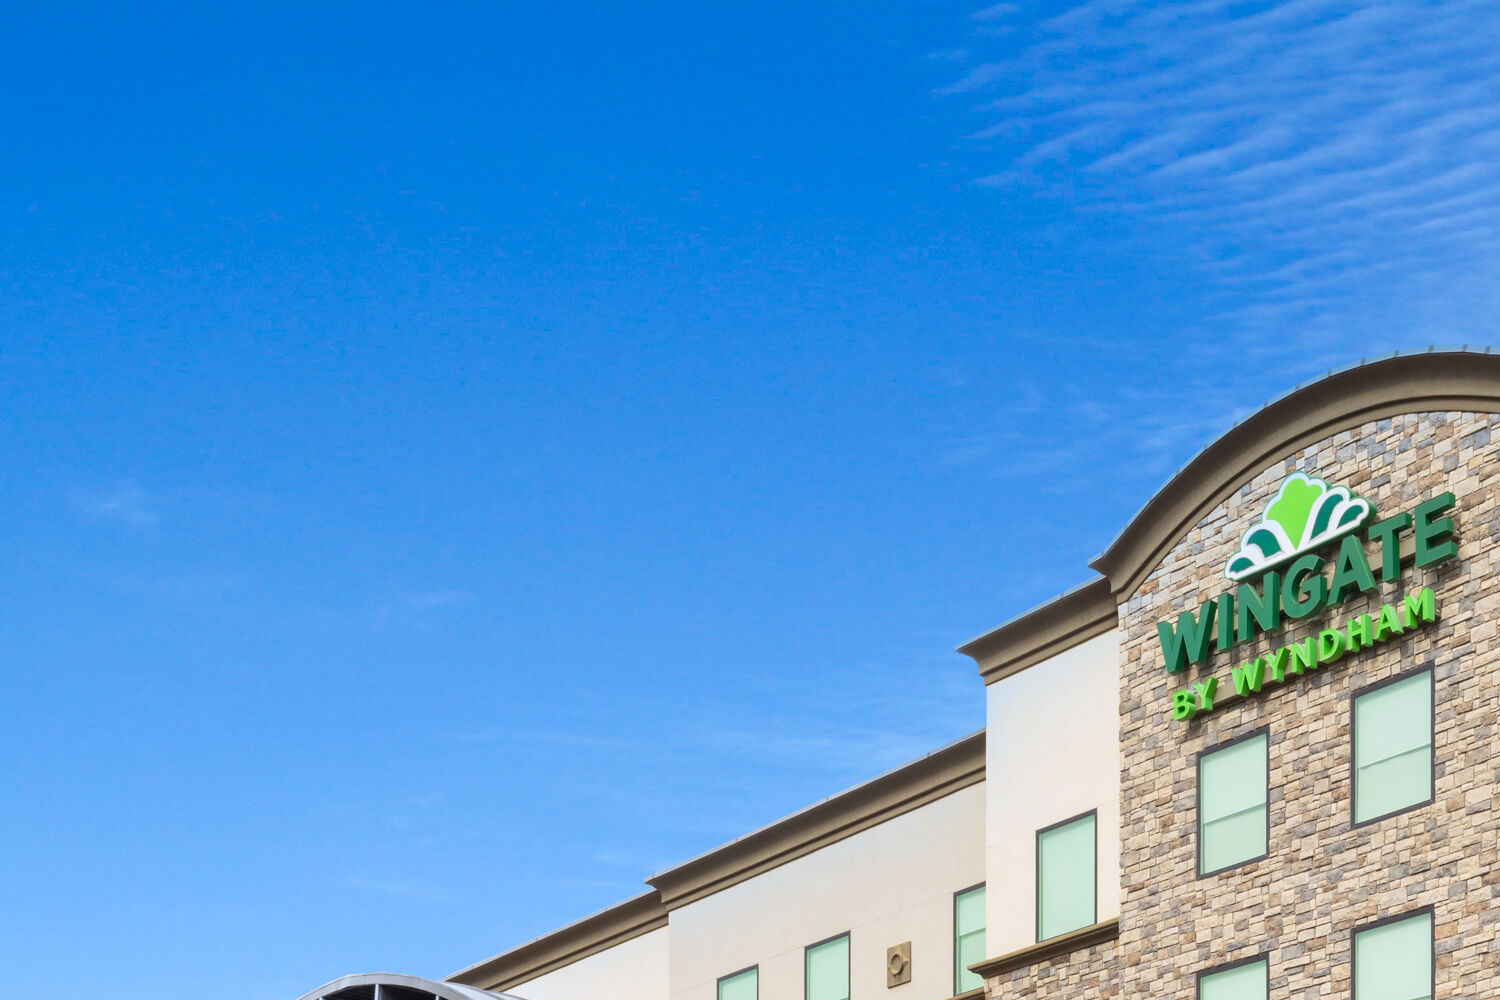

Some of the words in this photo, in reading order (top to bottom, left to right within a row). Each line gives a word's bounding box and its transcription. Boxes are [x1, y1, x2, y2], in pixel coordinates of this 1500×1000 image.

[1156, 491, 1459, 675] WINGATE
[1173, 676, 1219, 722] BY
[1231, 587, 1436, 697] WYNDHAM
